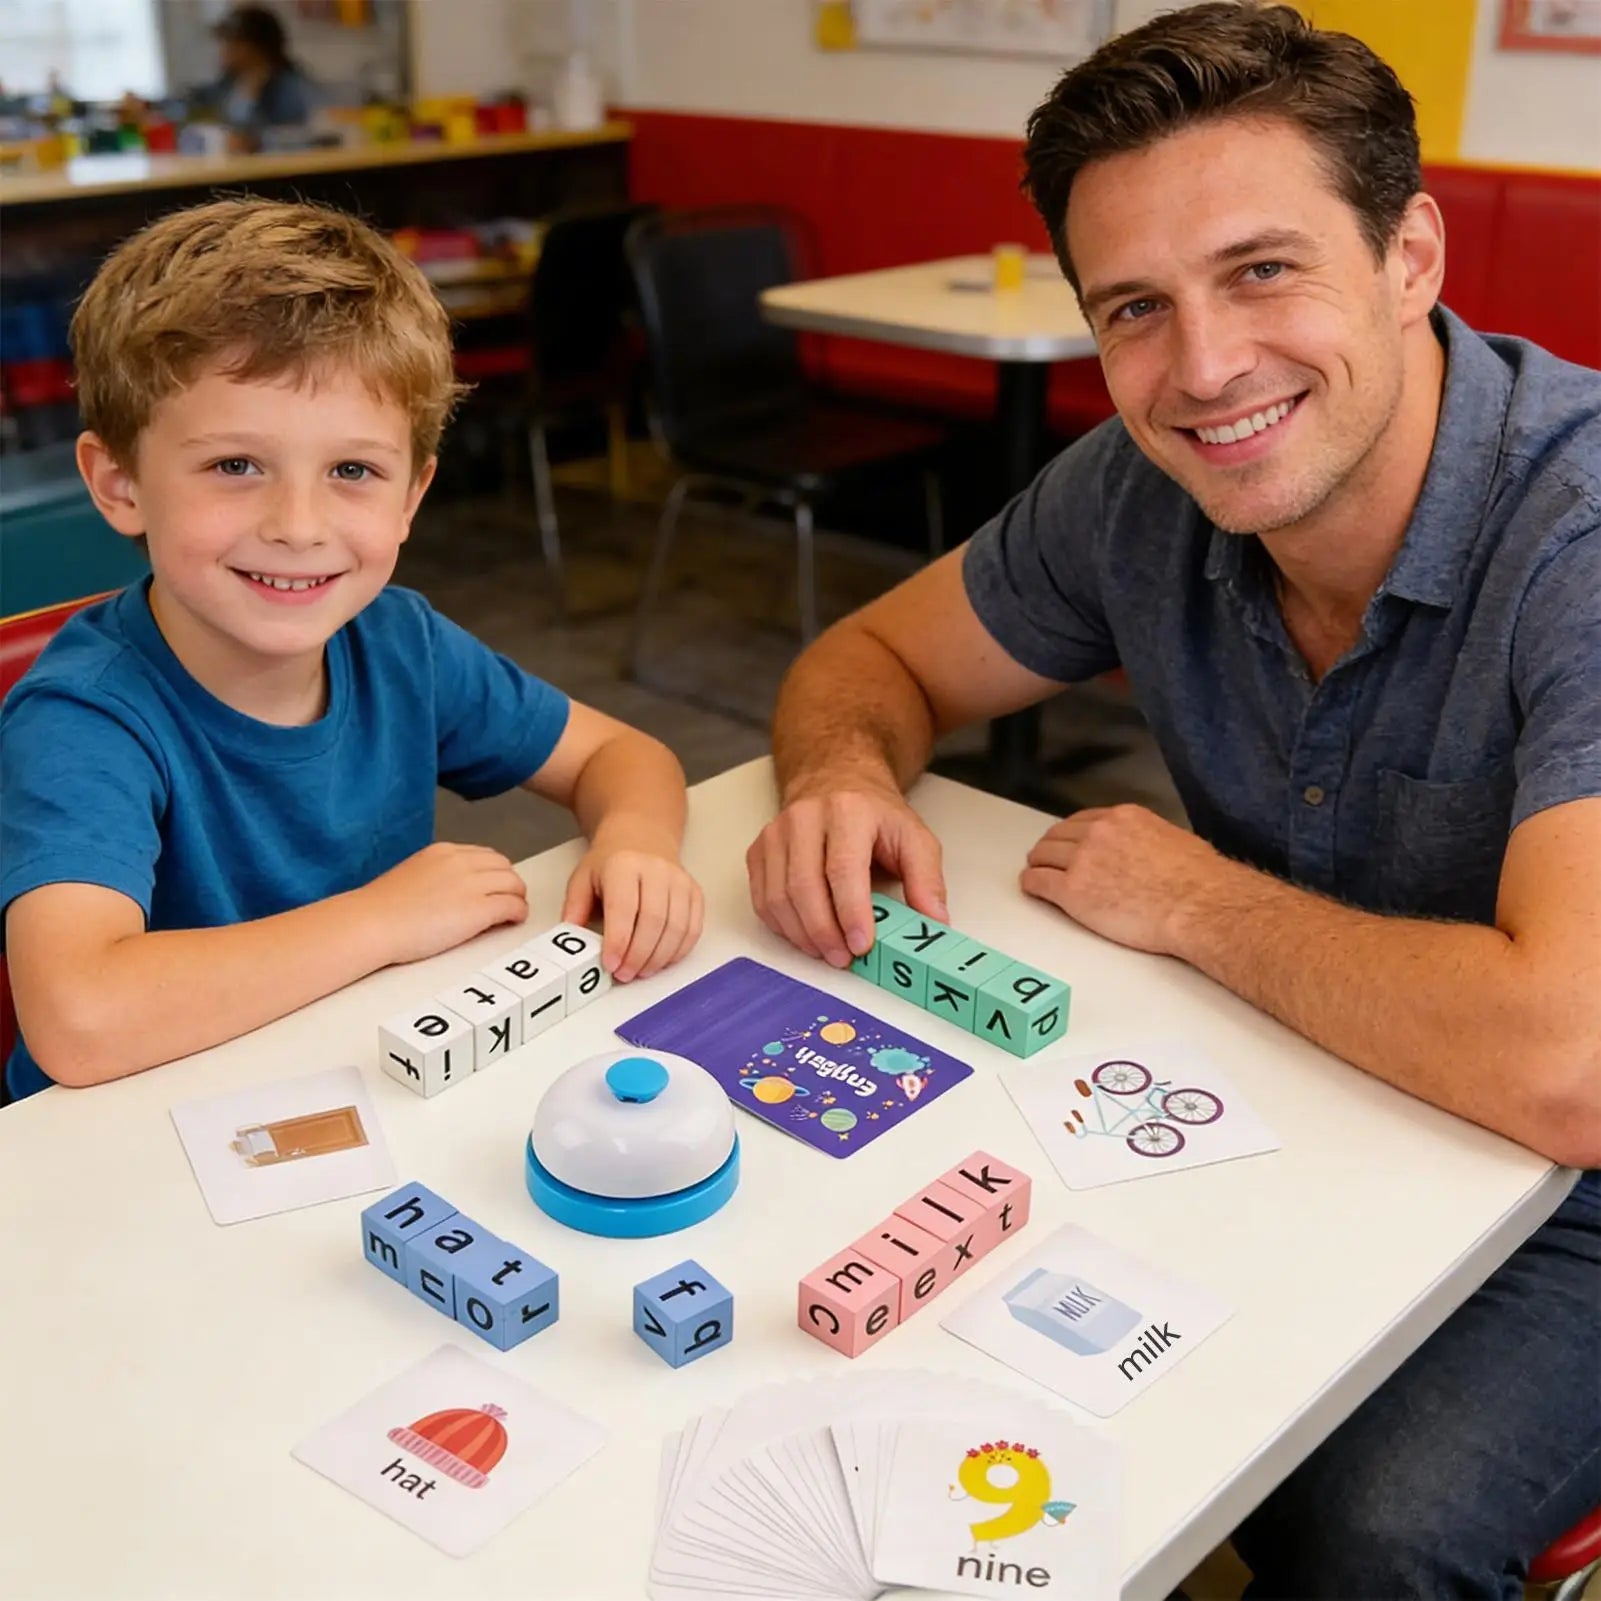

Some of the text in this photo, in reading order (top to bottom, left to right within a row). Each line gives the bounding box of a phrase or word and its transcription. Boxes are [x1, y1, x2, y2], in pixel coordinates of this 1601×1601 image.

[1117, 1321, 1183, 1382] milk
[380, 1457, 437, 1501] hat
[956, 1553, 1052, 1589] nine
